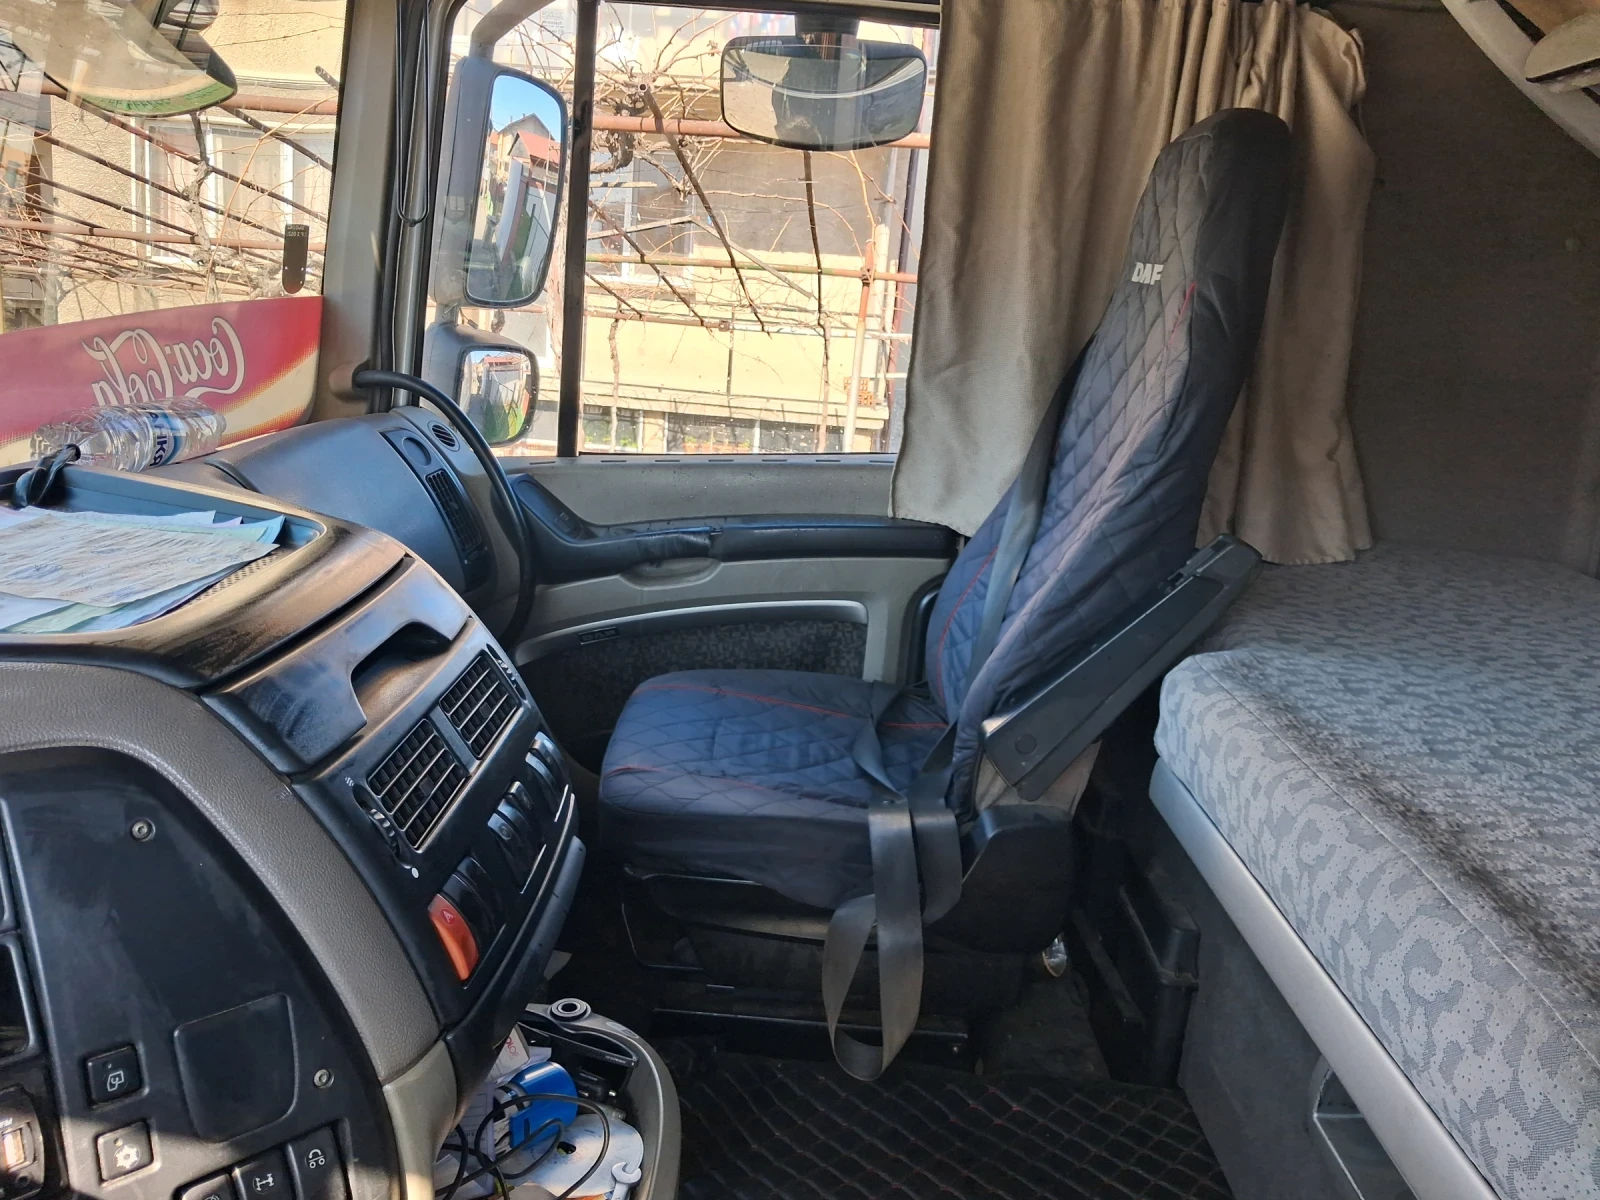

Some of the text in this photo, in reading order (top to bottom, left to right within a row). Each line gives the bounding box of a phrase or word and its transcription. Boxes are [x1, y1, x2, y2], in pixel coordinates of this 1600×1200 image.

[1131, 262, 1165, 286] DAF
[146, 410, 168, 467] АНКЯ
[582, 630, 616, 641] DAF
[504, 1036, 520, 1057] OLOP
